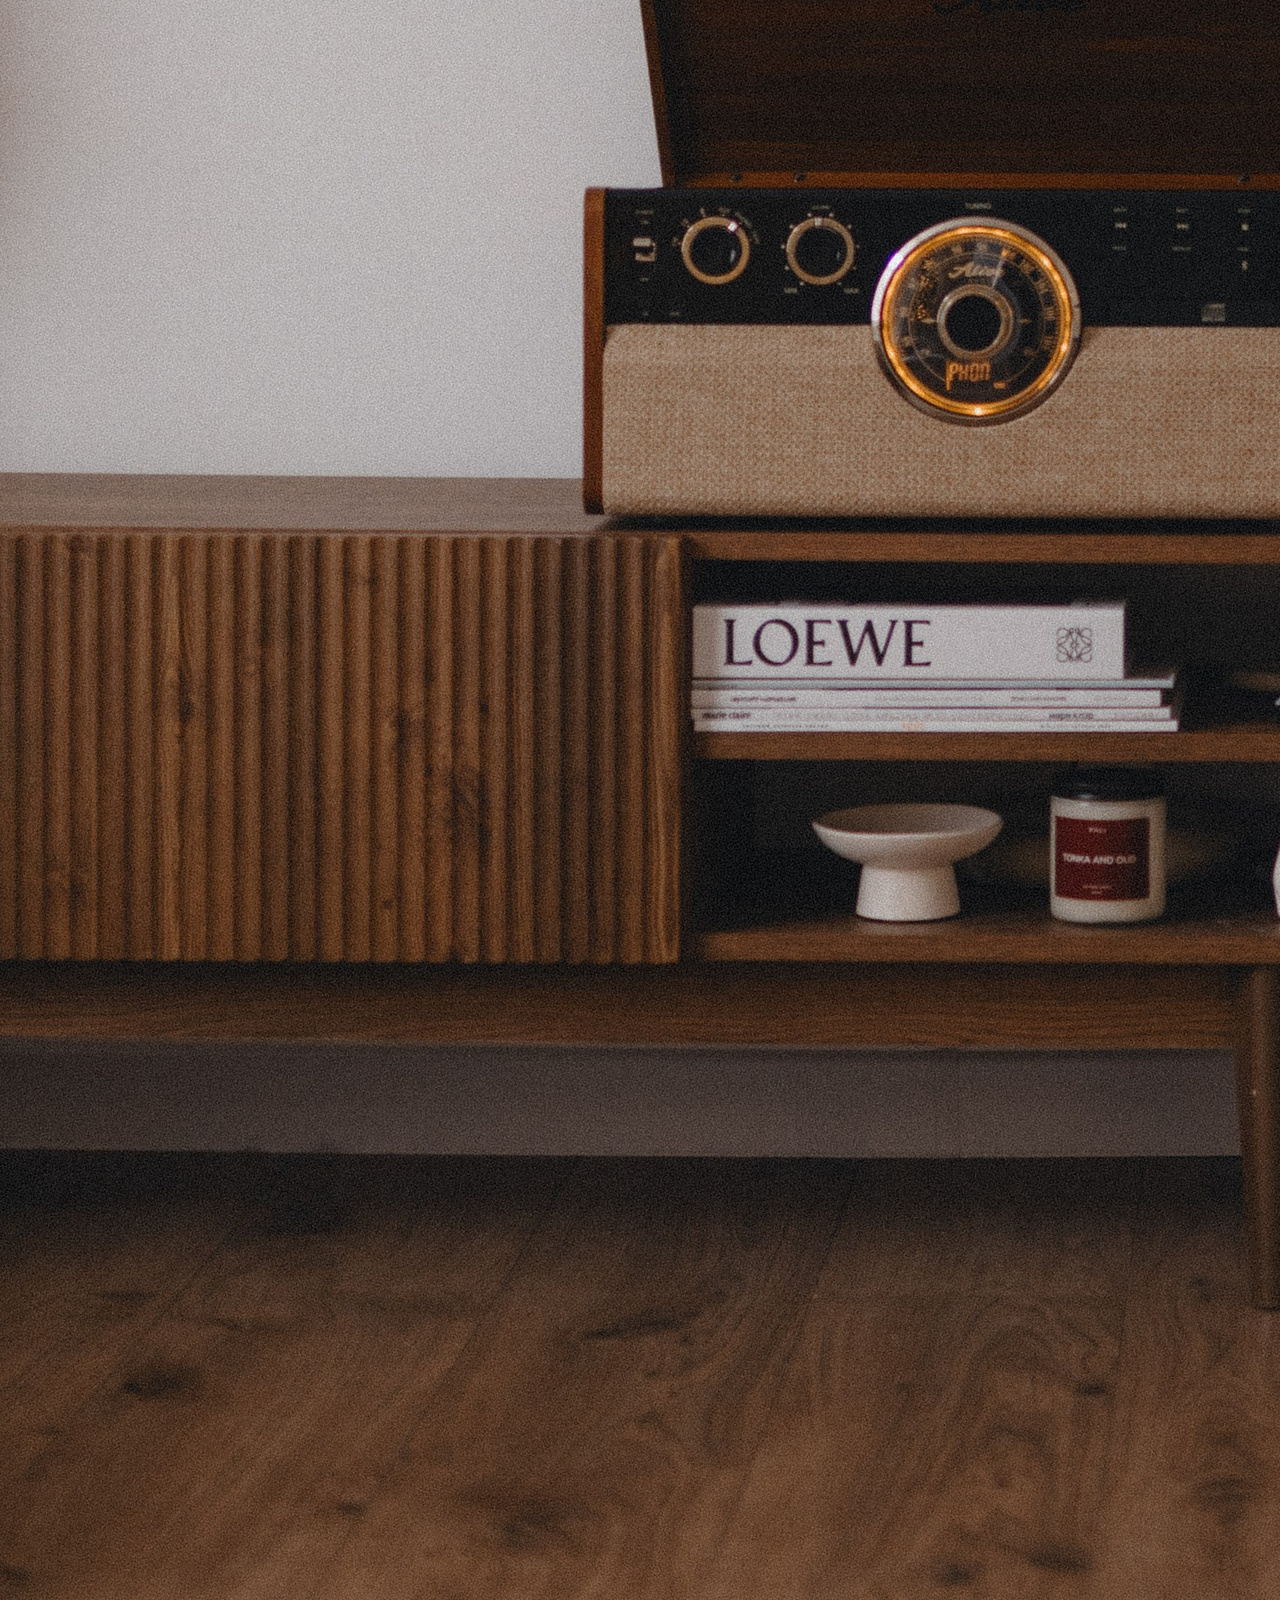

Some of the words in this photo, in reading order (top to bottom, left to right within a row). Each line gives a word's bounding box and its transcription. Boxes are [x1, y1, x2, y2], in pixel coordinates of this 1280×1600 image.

[723, 617, 931, 668] LOEWE
[1062, 852, 1091, 865] TONKA
[1092, 854, 1114, 866] AND
[1115, 854, 1137, 865] OUD
